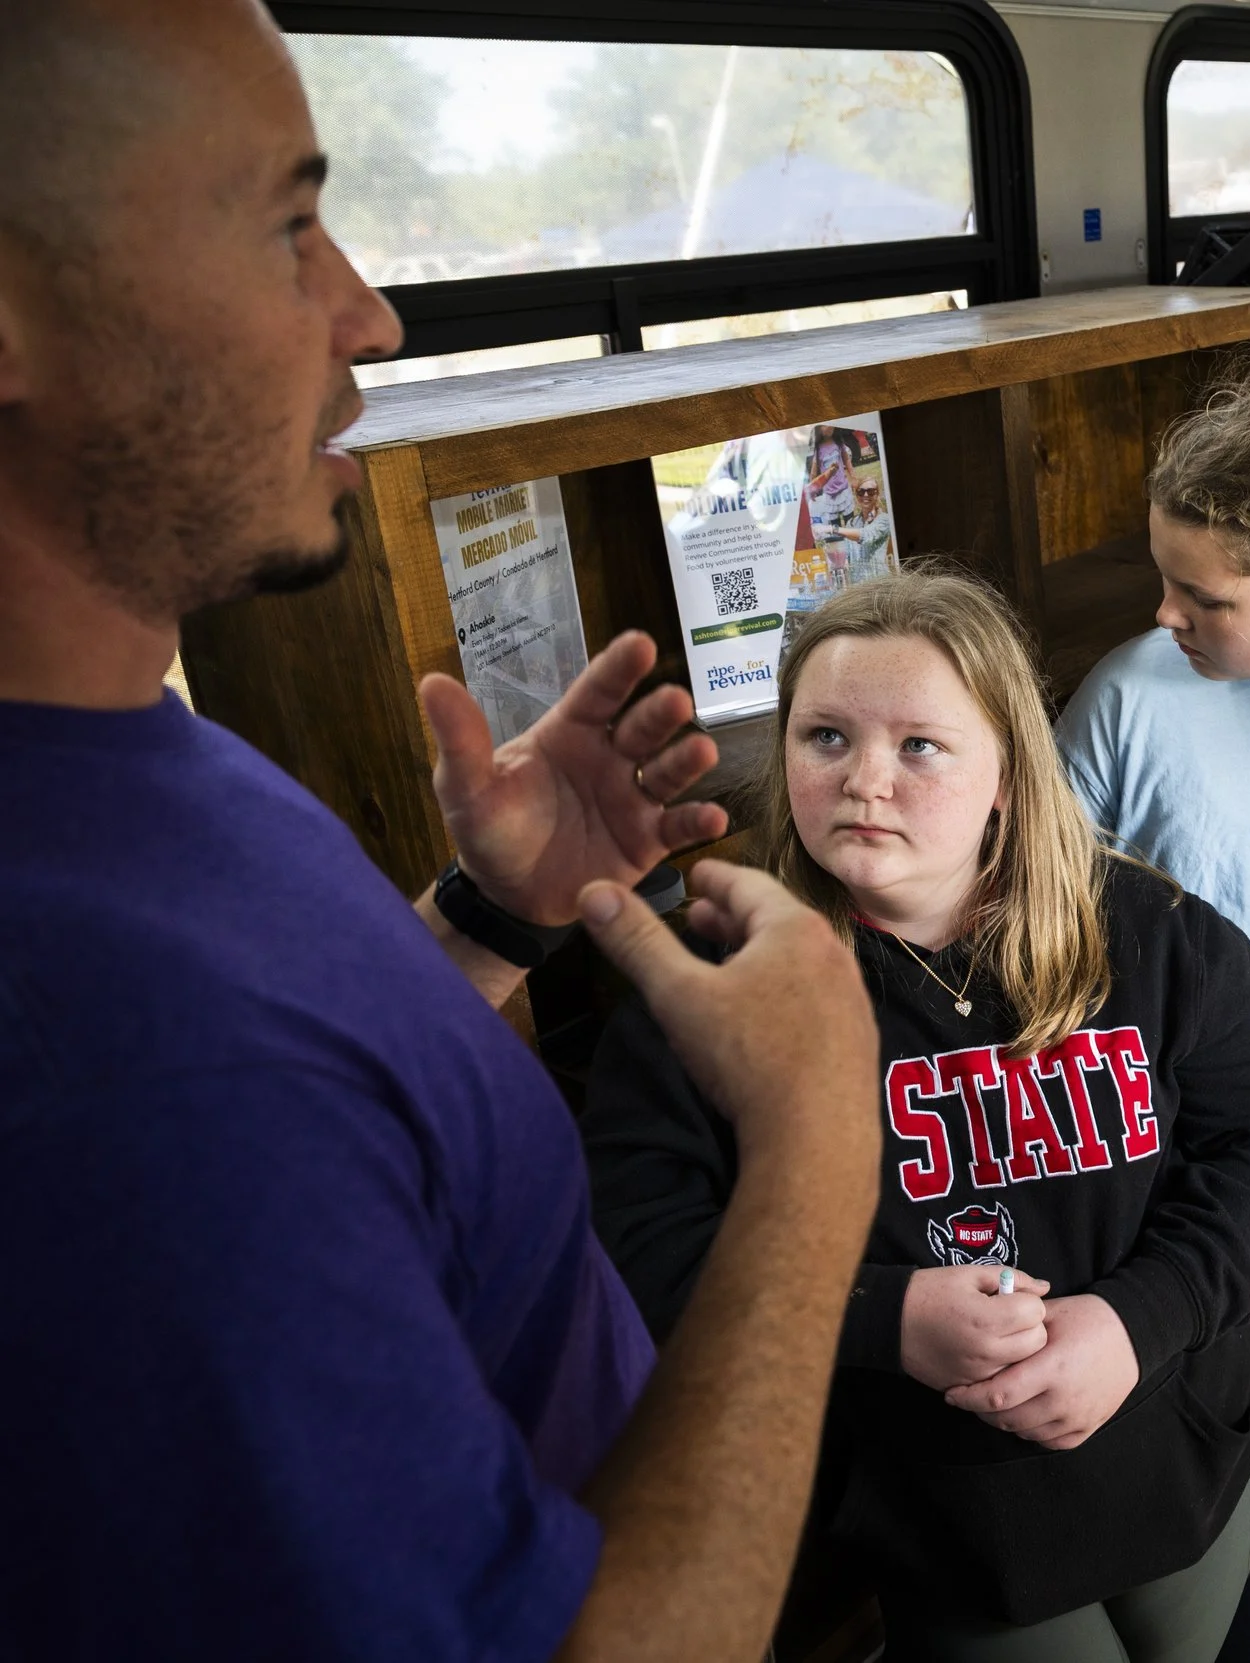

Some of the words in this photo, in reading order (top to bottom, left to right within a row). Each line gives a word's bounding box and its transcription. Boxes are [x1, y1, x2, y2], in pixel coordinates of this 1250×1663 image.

[456, 502, 494, 535] MOBILE
[494, 487, 531, 520] MARKET
[675, 483, 798, 518] VOLUNTEING!
[707, 525, 741, 536] difference
[461, 531, 508, 570] MERCADO
[508, 519, 538, 550] MÓVIL
[683, 540, 721, 551] community
[723, 537, 737, 545] and
[737, 533, 752, 543] help
[685, 551, 707, 561] Revive
[708, 545, 754, 558] Communities
[754, 539, 781, 549] through
[686, 562, 704, 572] Food
[705, 560, 714, 569] by
[715, 553, 758, 566] volunteering
[759, 550, 773, 559] with
[473, 575, 495, 592] County
[502, 559, 528, 578] Condado
[528, 555, 537, 566] de
[469, 613, 496, 635] Ahoskie
[707, 665, 735, 679] ripe
[746, 659, 764, 670] for
[709, 665, 772, 691] revival
[885, 1026, 1160, 1202] STATE
[960, 1229, 970, 1241] NC
[971, 1229, 993, 1241] STATE
